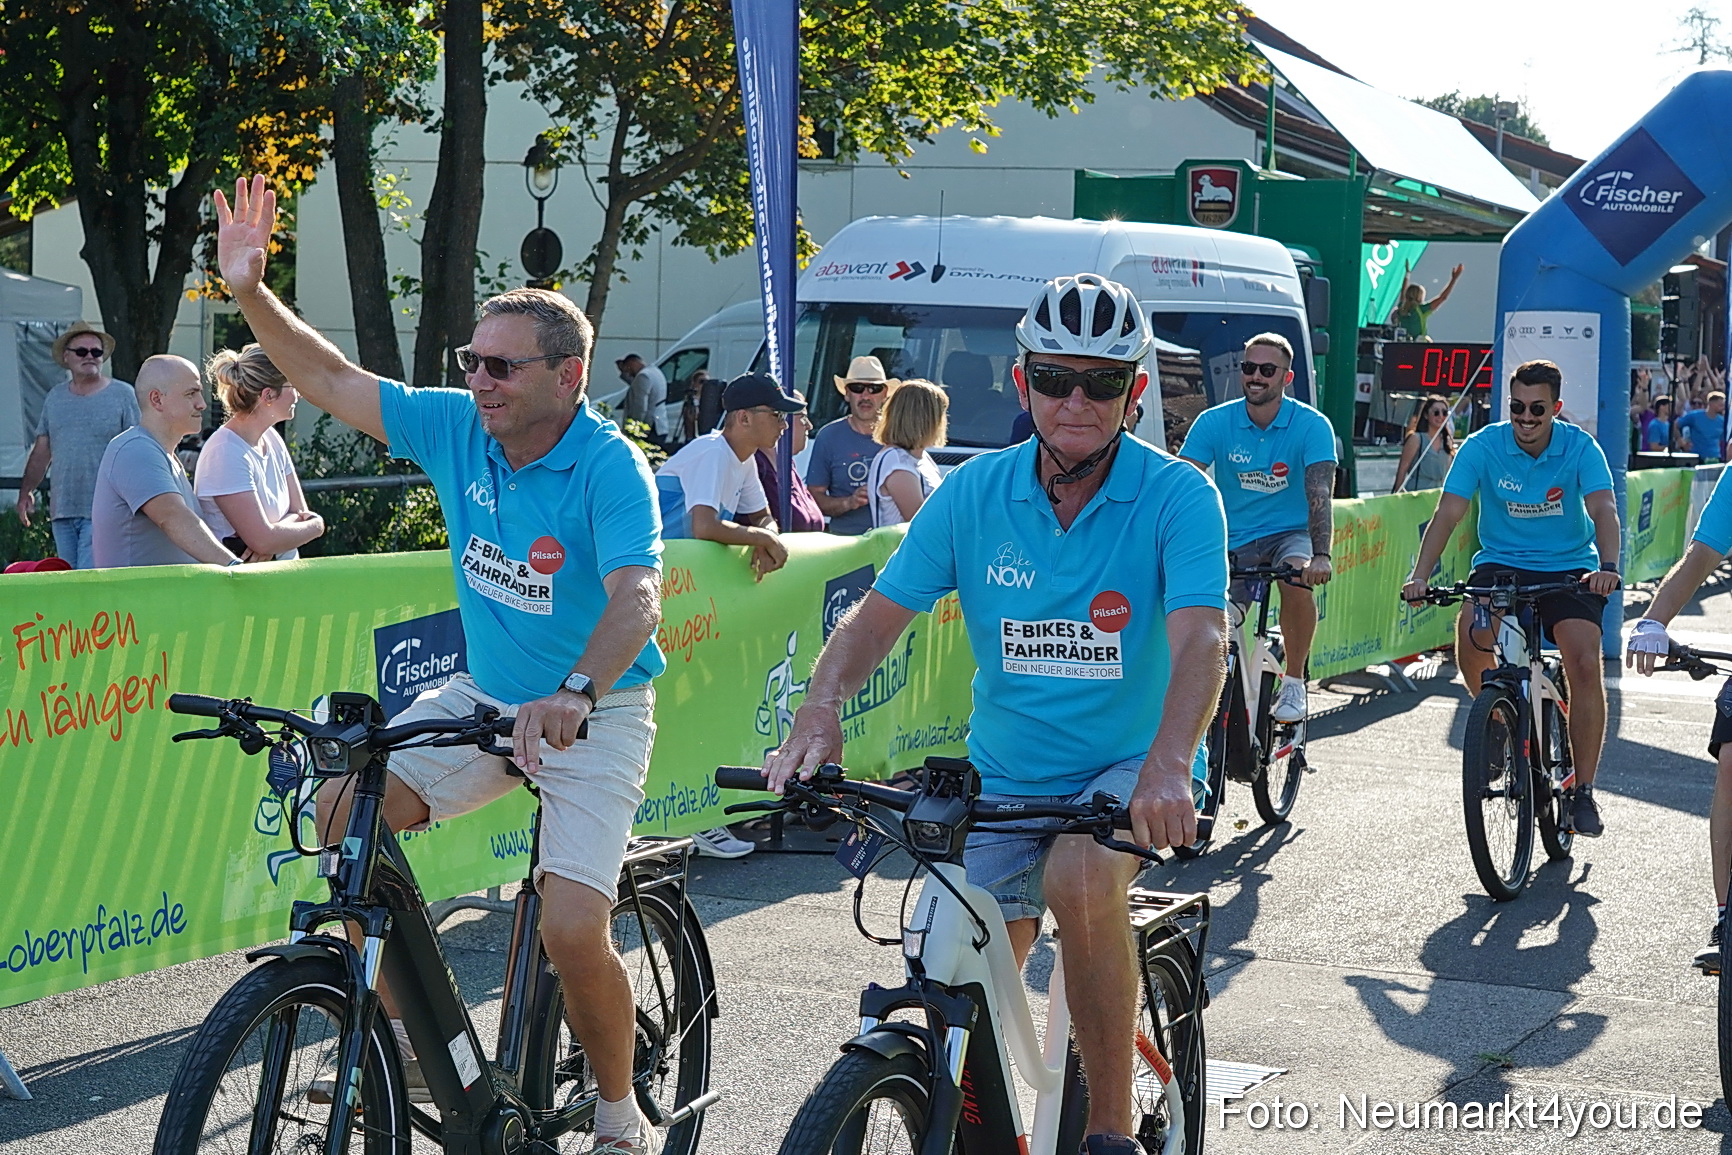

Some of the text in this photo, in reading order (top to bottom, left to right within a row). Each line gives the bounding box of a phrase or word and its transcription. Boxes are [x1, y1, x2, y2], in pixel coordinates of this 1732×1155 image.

[1595, 185, 1683, 204] Fischer
[1602, 202, 1674, 213] AUTOMOBILE
[1201, 213, 1225, 222] 1628
[815, 261, 888, 277] abavent
[949, 271, 1050, 284] DATASPOR
[1228, 453, 1252, 464] NOW
[1498, 479, 1523, 493] NOW
[468, 537, 530, 578] E-BIKE &
[531, 551, 563, 560] Pilsach
[993, 542, 1032, 568] Bike
[986, 565, 1036, 589] NOW
[504, 594, 551, 613] BIKE-STORE
[1093, 605, 1128, 618] Pilsach
[657, 596, 721, 663] änger!
[1004, 622, 1094, 640] E-BIKES &
[12, 610, 140, 670] Firmen
[1005, 641, 1119, 661] FAHRRÄDER
[396, 652, 459, 686] Fischer
[1006, 662, 1121, 677] DEIN NEUER BIKE-STORE
[41, 651, 170, 741] länger!
[843, 716, 865, 744] arkt
